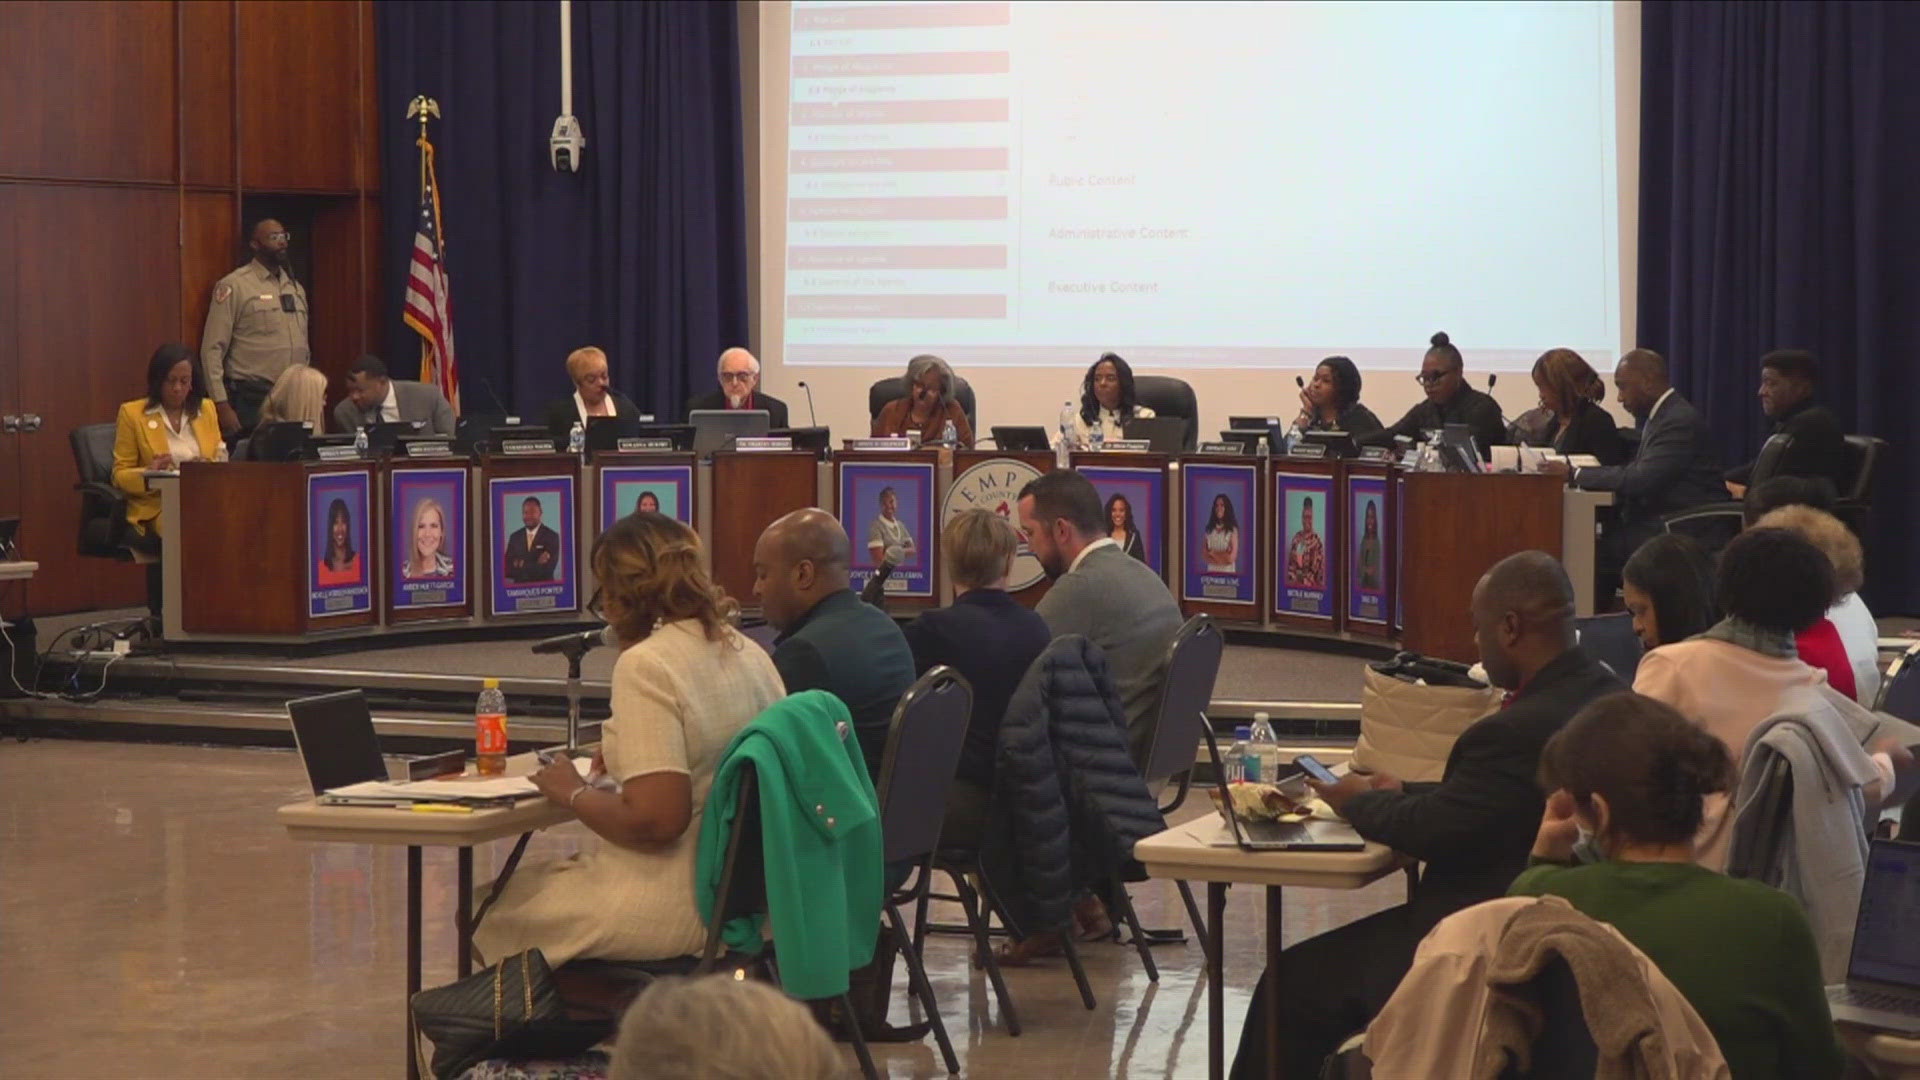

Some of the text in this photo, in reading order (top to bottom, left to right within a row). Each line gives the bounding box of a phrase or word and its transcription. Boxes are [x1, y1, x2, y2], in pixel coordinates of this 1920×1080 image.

[1048, 173, 1137, 187] Public Content
[1048, 227, 1190, 240] Administrative Content
[1048, 281, 1159, 294] Executive Content
